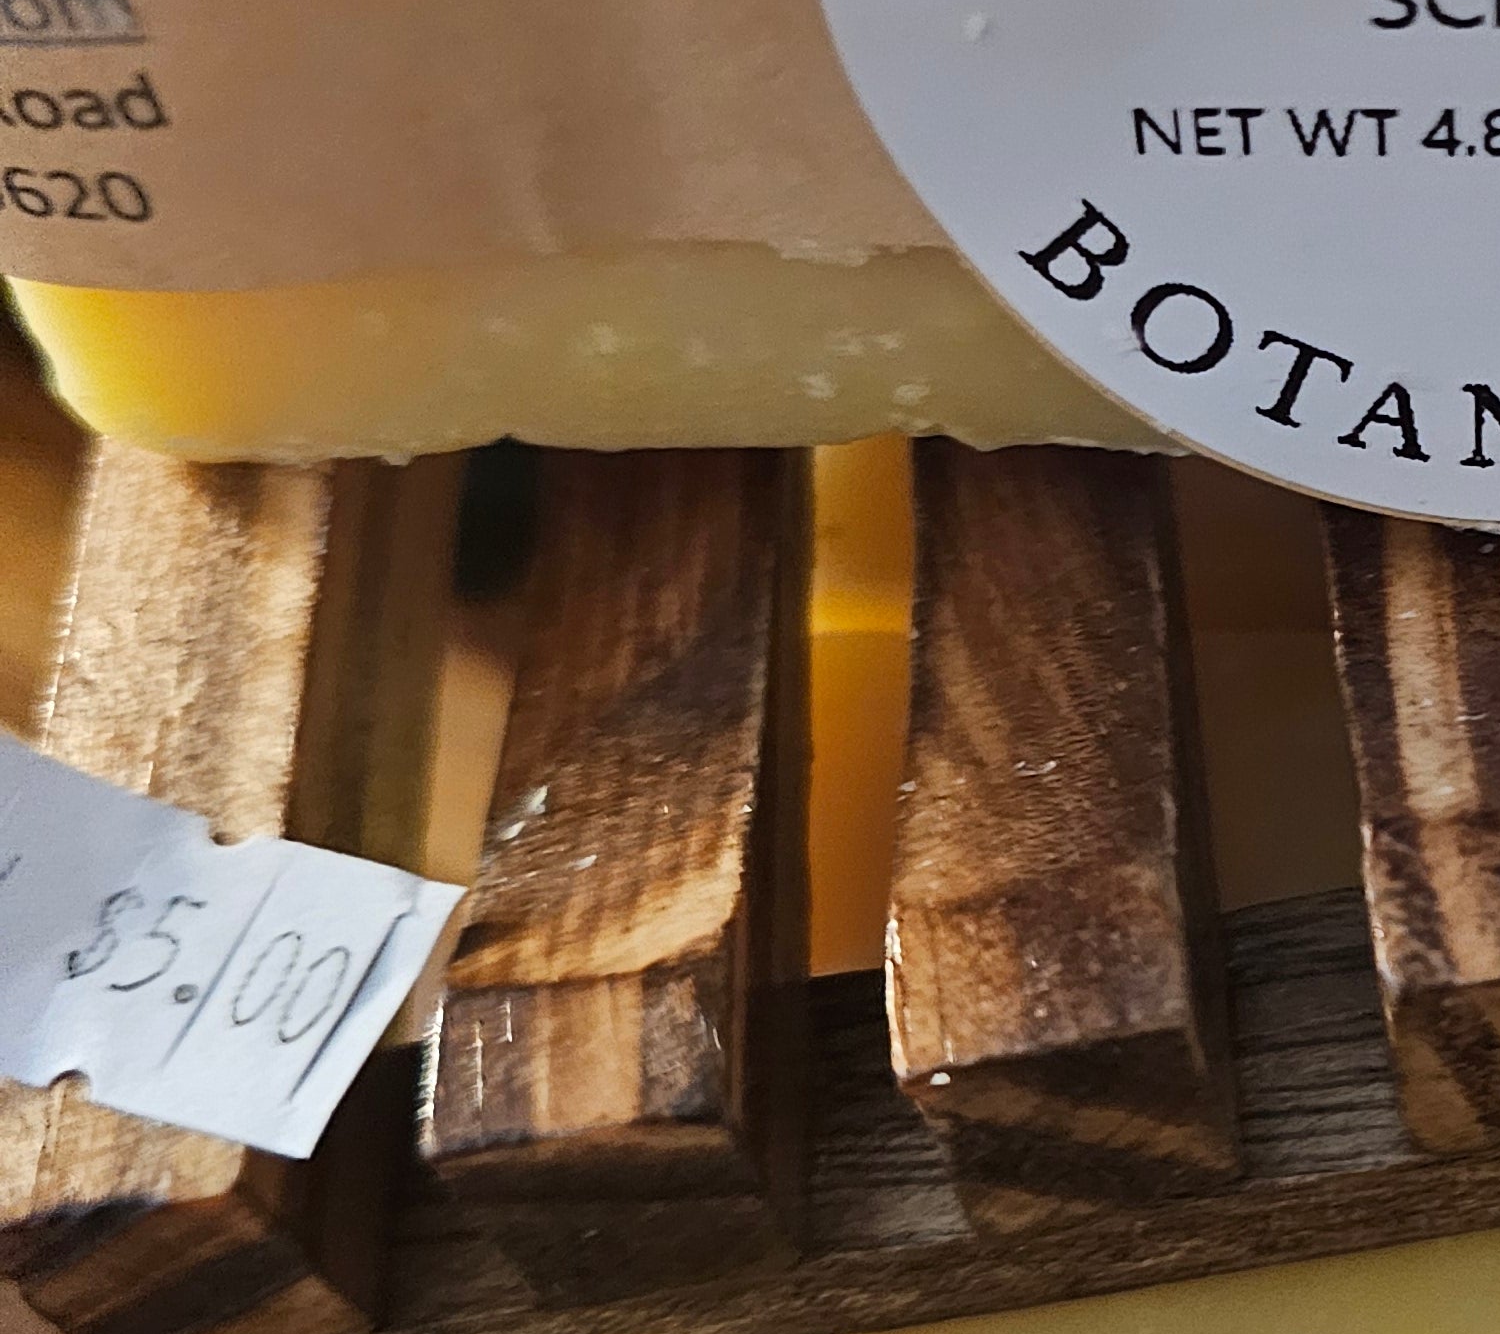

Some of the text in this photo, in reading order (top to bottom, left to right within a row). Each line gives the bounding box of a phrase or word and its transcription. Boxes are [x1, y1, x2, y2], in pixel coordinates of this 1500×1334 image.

[0, 69, 170, 131] oad
[1131, 106, 1266, 158] NET
[1284, 107, 1401, 158] WT
[0, 167, 153, 223] 620
